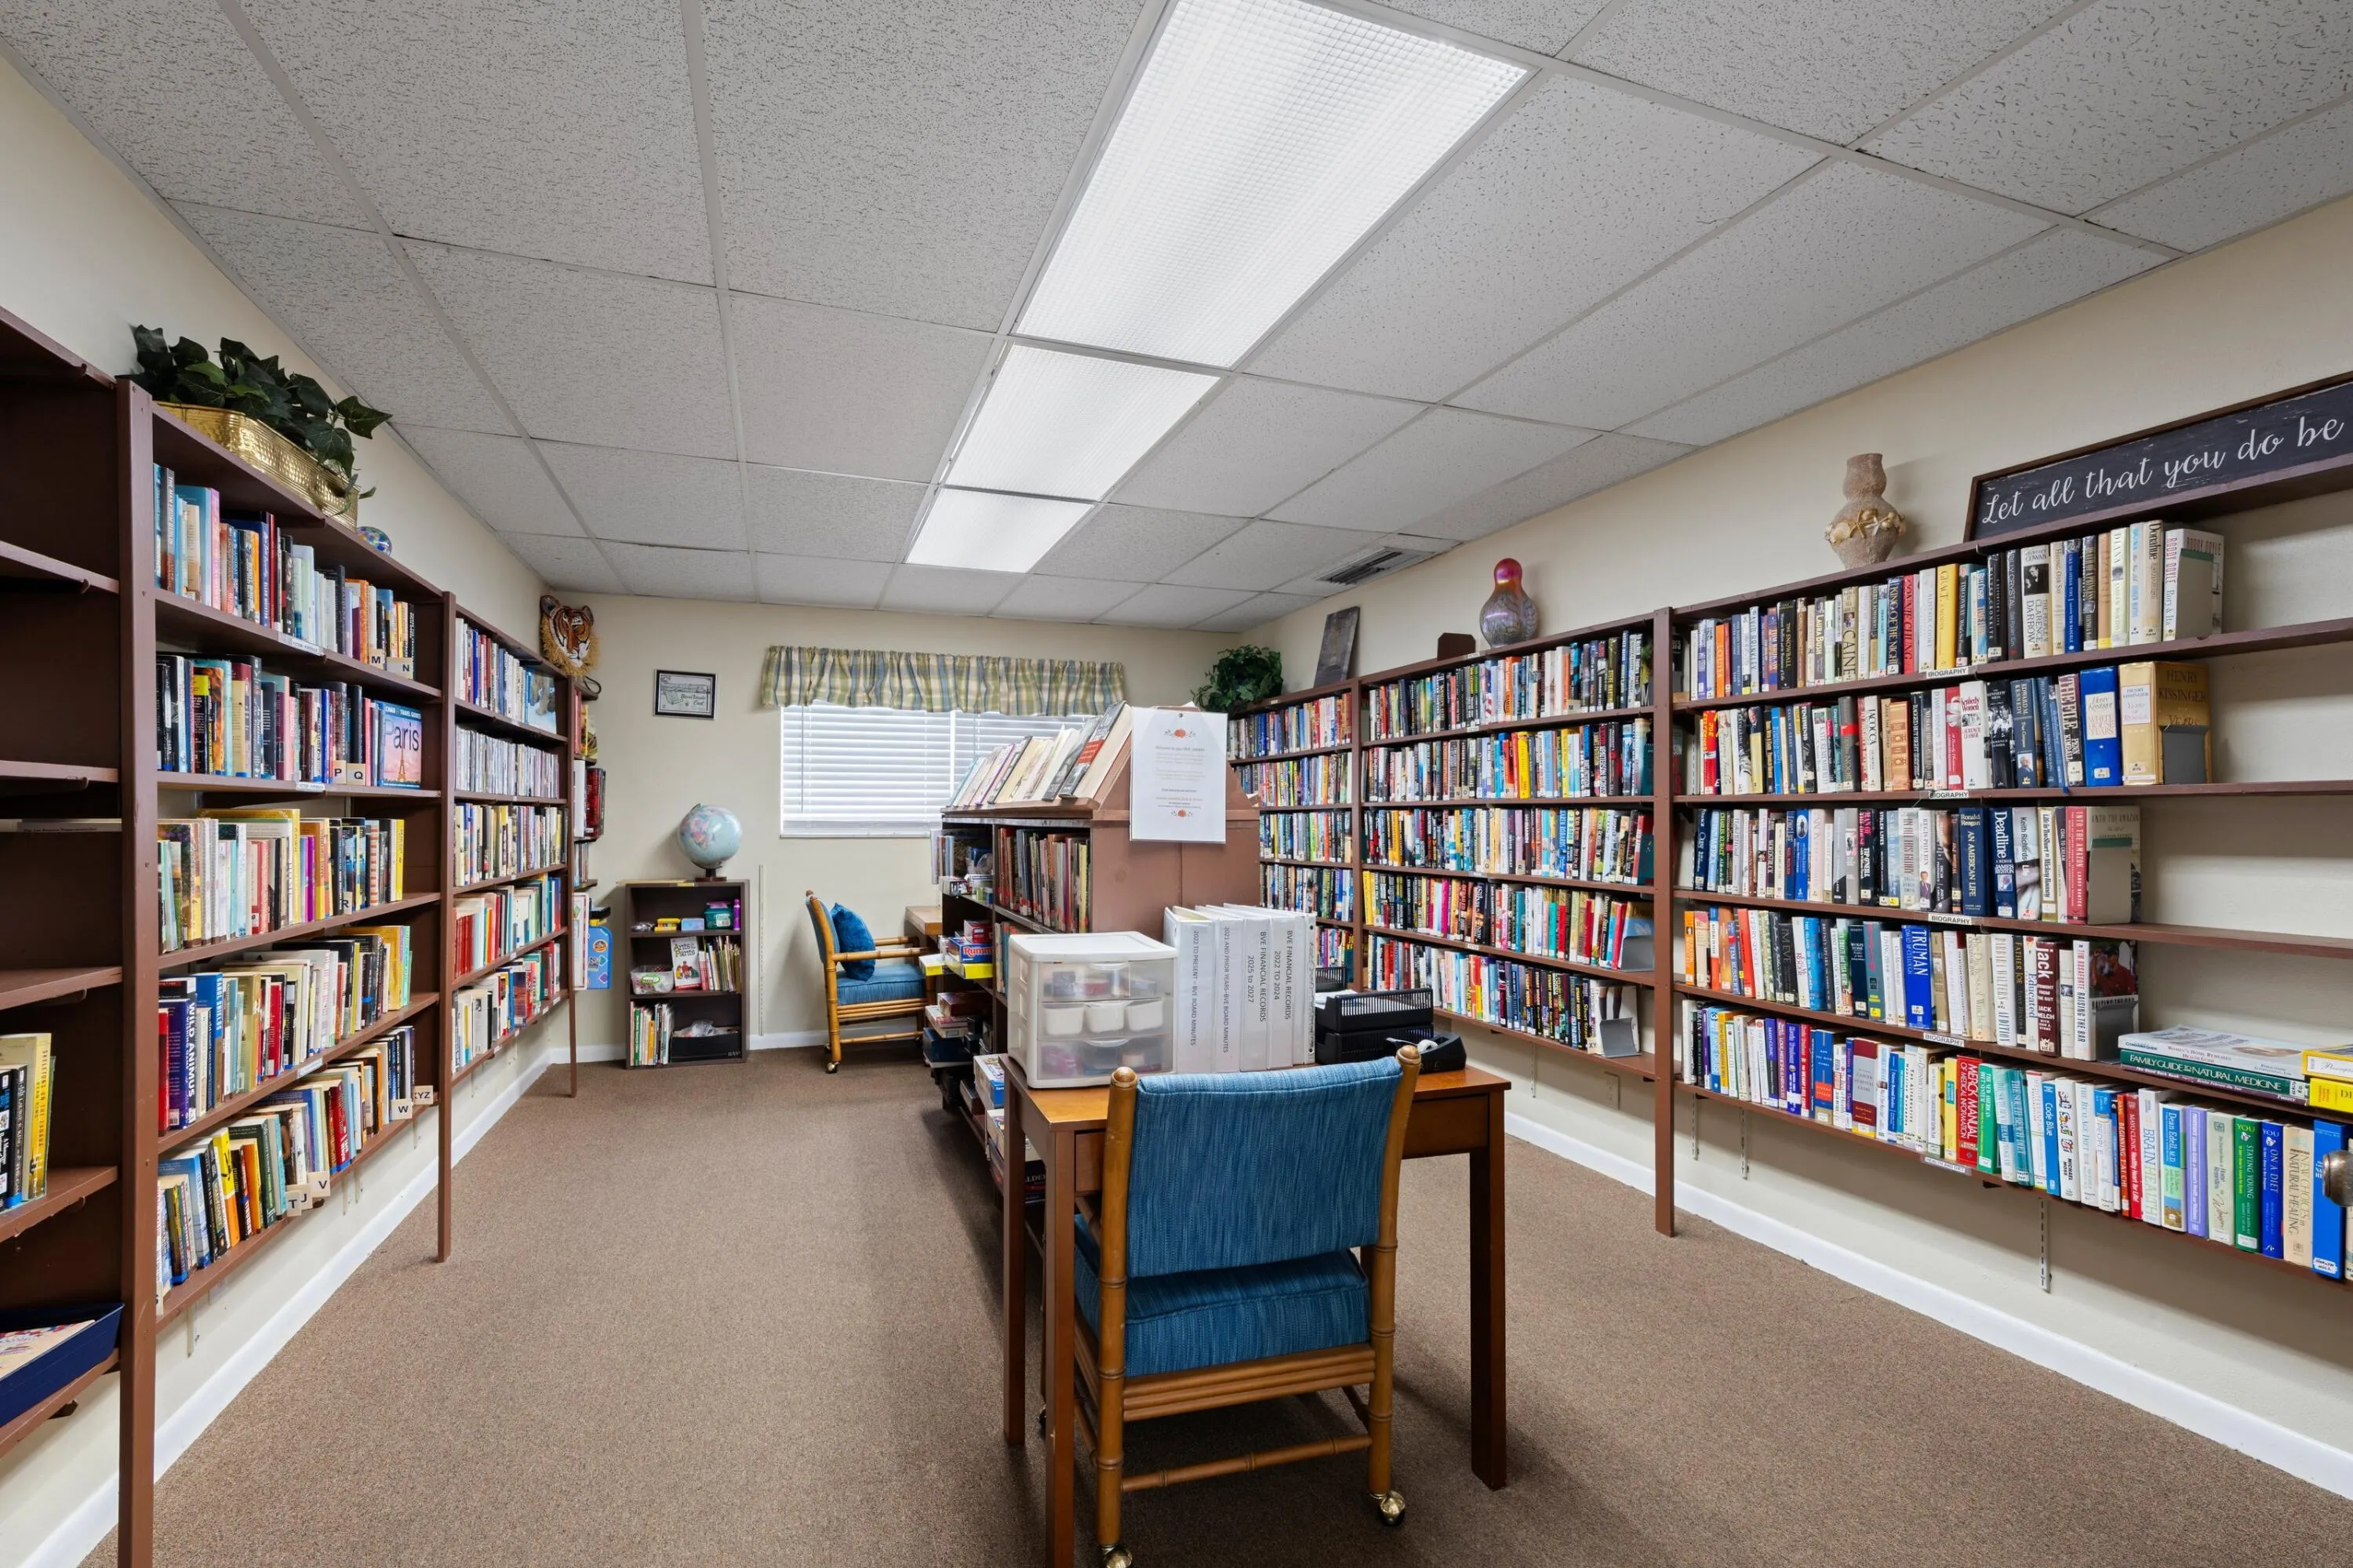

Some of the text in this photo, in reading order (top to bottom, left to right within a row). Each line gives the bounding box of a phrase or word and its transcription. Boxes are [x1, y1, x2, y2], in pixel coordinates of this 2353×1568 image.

[1981, 415, 2345, 525] Let all that you do be
[2113, 533, 2122, 564] DIANA
[2148, 522, 2162, 560] Donahue
[2165, 537, 2177, 584] RODDY DOYLE
[2165, 589, 2175, 607] Rory
[1888, 586, 1899, 665] KING OF THE NIGHT
[1904, 579, 1913, 660] CONNIE CHUNG
[2026, 600, 2035, 644] DARROW
[2165, 615, 2173, 626] Ita
[1816, 614, 1824, 654] LAURA BUSH
[371, 656, 381, 664] M
[1842, 630, 1856, 675] CAINE
[1928, 668, 1967, 678] BIOGRAPHY
[2166, 670, 2197, 683] HENRY
[2059, 677, 2078, 730] THE FILE
[2158, 687, 2209, 703] KISSINGER
[384, 719, 420, 751] Paris
[1868, 708, 1877, 745] IACOCCA
[2064, 733, 2073, 762] KIMBALL
[2071, 737, 2080, 755] PENN
[334, 768, 342, 777] P
[354, 771, 364, 780] Q
[1967, 831, 1975, 842] AN
[1994, 811, 2009, 859] Deadline
[2075, 811, 2084, 868] INTO THE AMAZON
[1931, 915, 1971, 924] BIOGRAPHY
[673, 943, 690, 951] Ants
[675, 949, 696, 958] Pants
[1193, 945, 1198, 954] TO
[1780, 928, 1791, 964] I'M EVE
[1911, 929, 1929, 977] TRUMAN
[2037, 948, 2054, 979] jack
[1247, 975, 1254, 984] to
[1274, 970, 1281, 980] TO
[2028, 972, 2038, 1019] Educated
[1925, 1034, 1963, 1045] BIOGRAPHY
[2129, 1053, 2158, 1068] FAMILY
[2157, 1060, 2183, 1072] GUIDE
[2191, 1067, 2233, 1082] NATURAL
[2235, 1075, 2282, 1091] MEDICINE
[414, 1091, 431, 1100] YZ
[1967, 1064, 1978, 1139] MERCK MANUAL
[398, 1105, 409, 1114] W
[2045, 1102, 2053, 1119] Code
[2168, 1112, 2178, 1150] Dean Edell,
[2236, 1122, 2256, 1133] YOU
[2262, 1128, 2280, 1137] YOU
[2270, 1148, 2278, 1164] ON
[2300, 1154, 2311, 1177] NEW
[2143, 1127, 2158, 1217] BRAIN HEALTH
[2246, 1144, 2254, 1199] STAYING YOUNG
[318, 1180, 328, 1189] V
[2270, 1173, 2279, 1194] DIET
[2288, 1151, 2300, 1235] NATURAL HEALING
[288, 1199, 297, 1210] T
[300, 1193, 307, 1203] J
[2301, 1178, 2311, 1220] CHOICES
